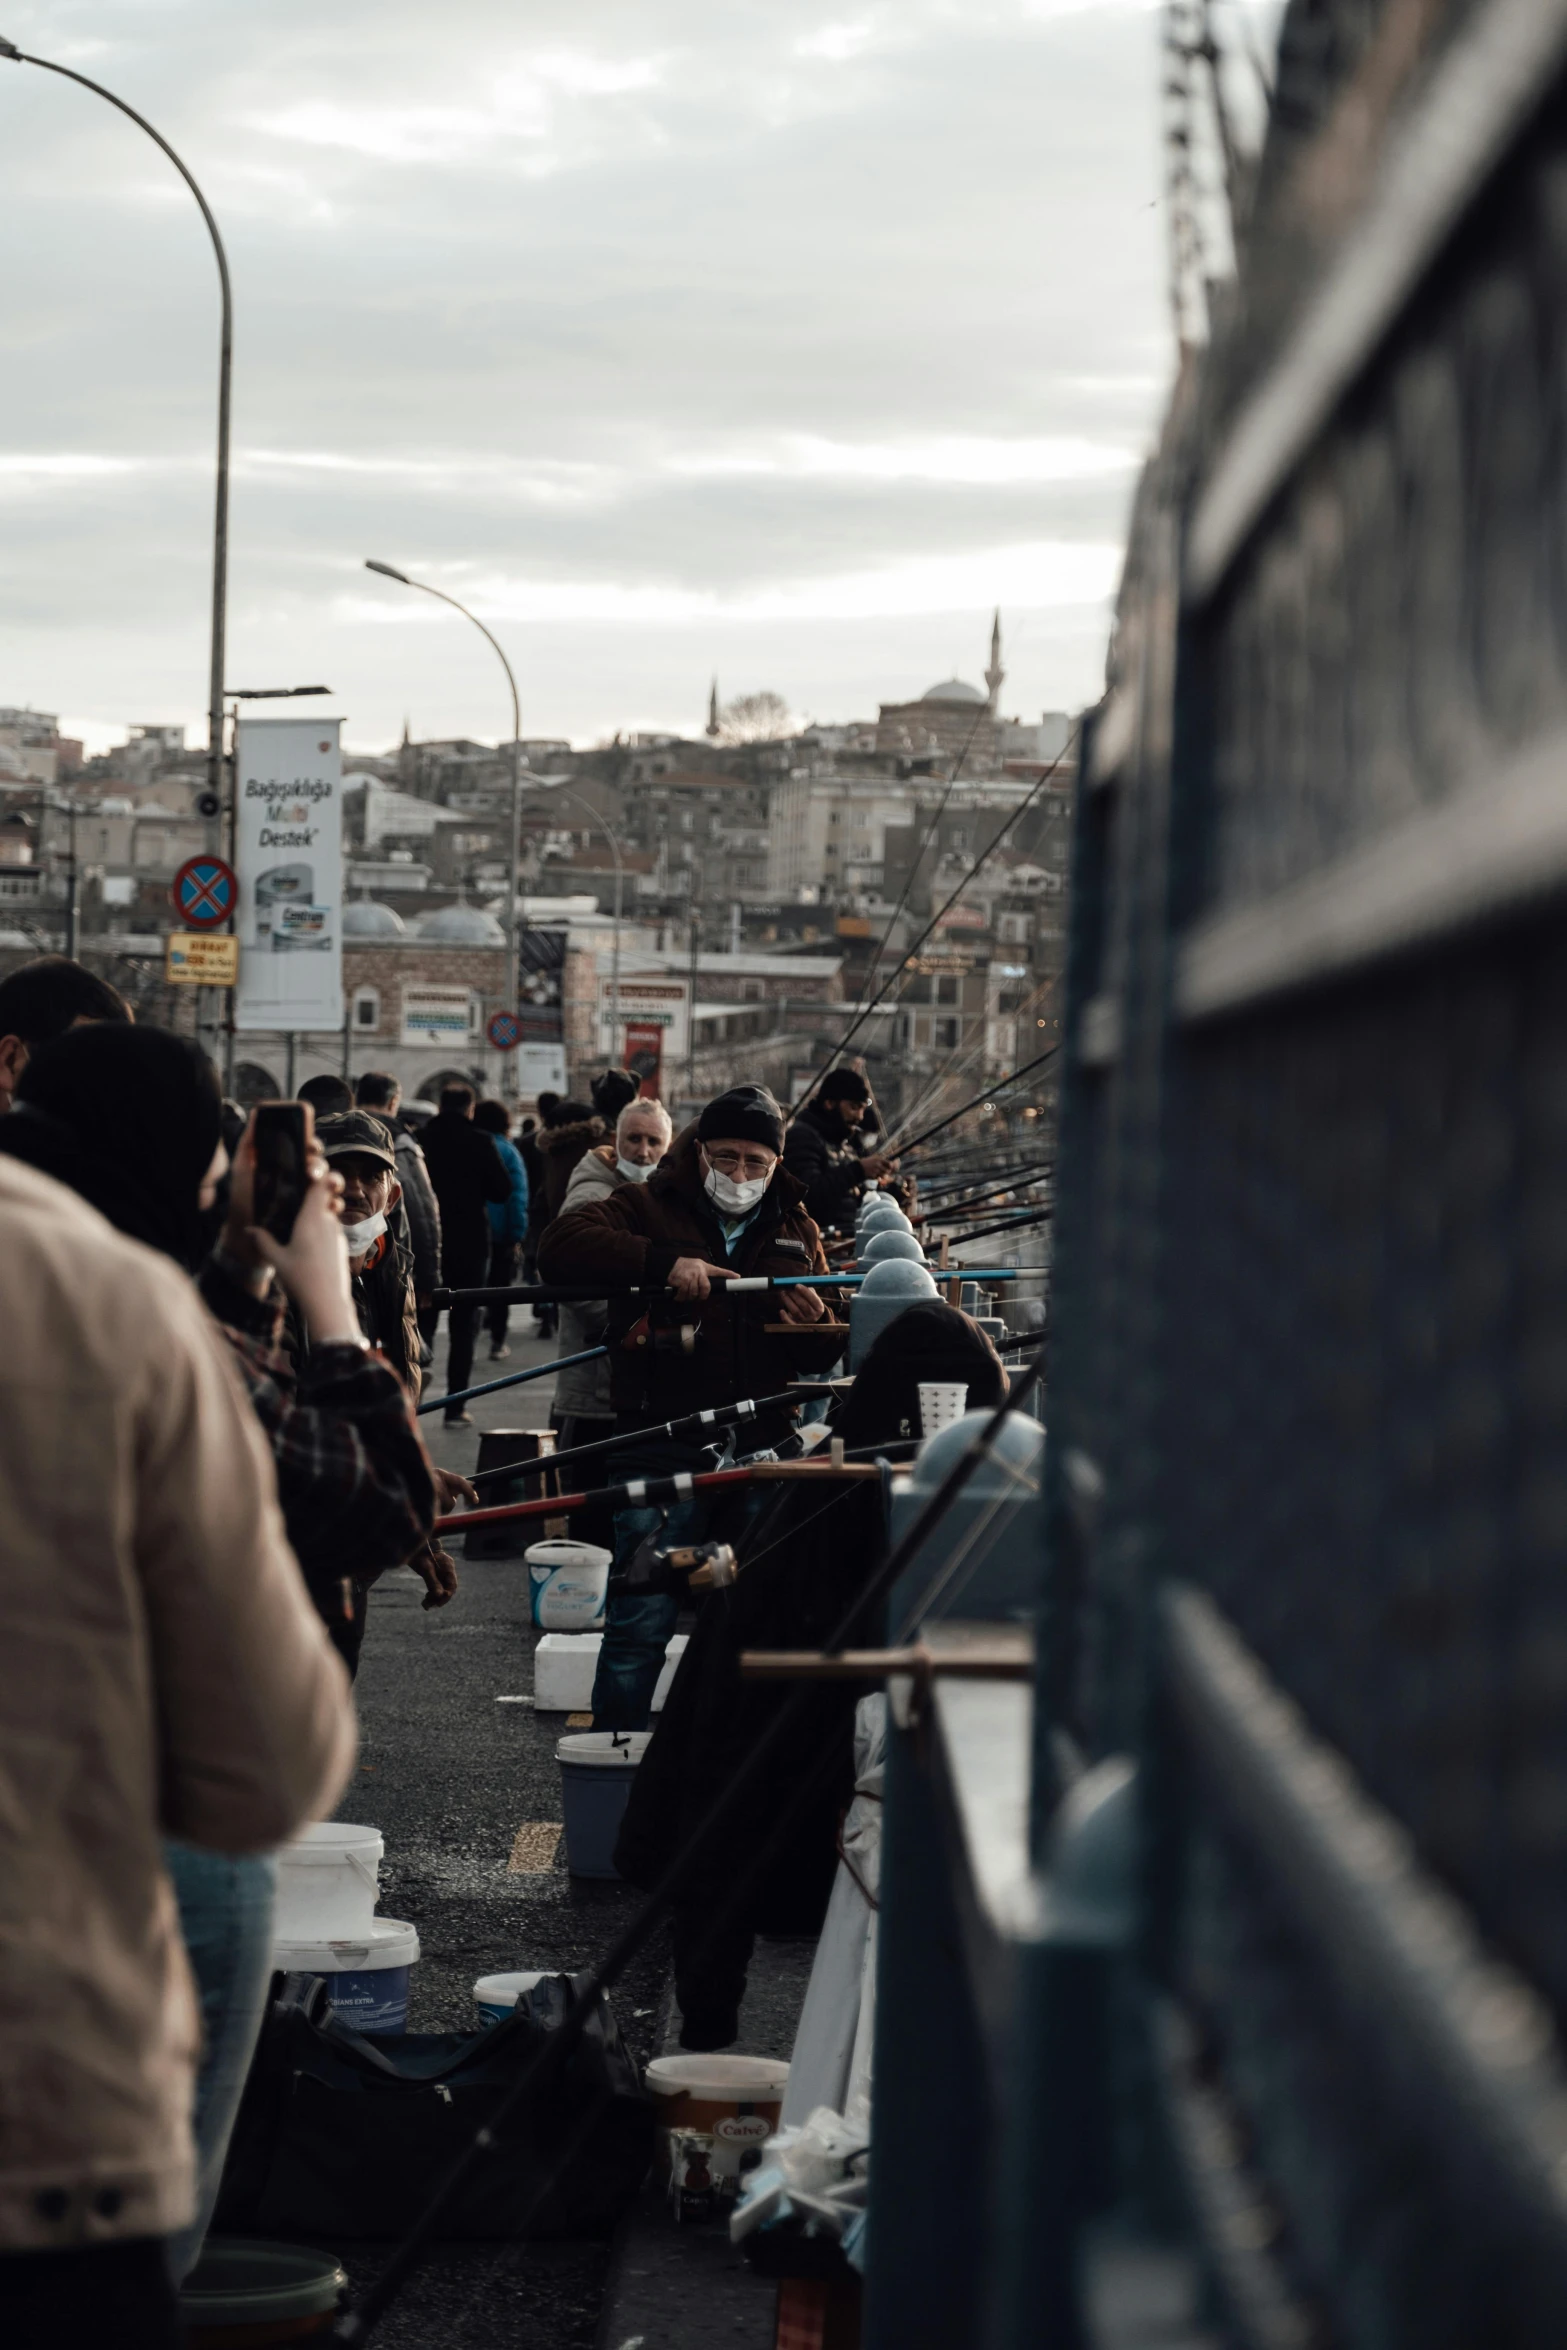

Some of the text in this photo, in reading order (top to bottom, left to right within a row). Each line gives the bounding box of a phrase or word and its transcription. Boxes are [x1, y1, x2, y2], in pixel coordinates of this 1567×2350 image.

[245, 778, 333, 804] Bağışıklığa
[354, 1997, 375, 2006] EXTRA
[723, 2124, 765, 2137] Calvé
